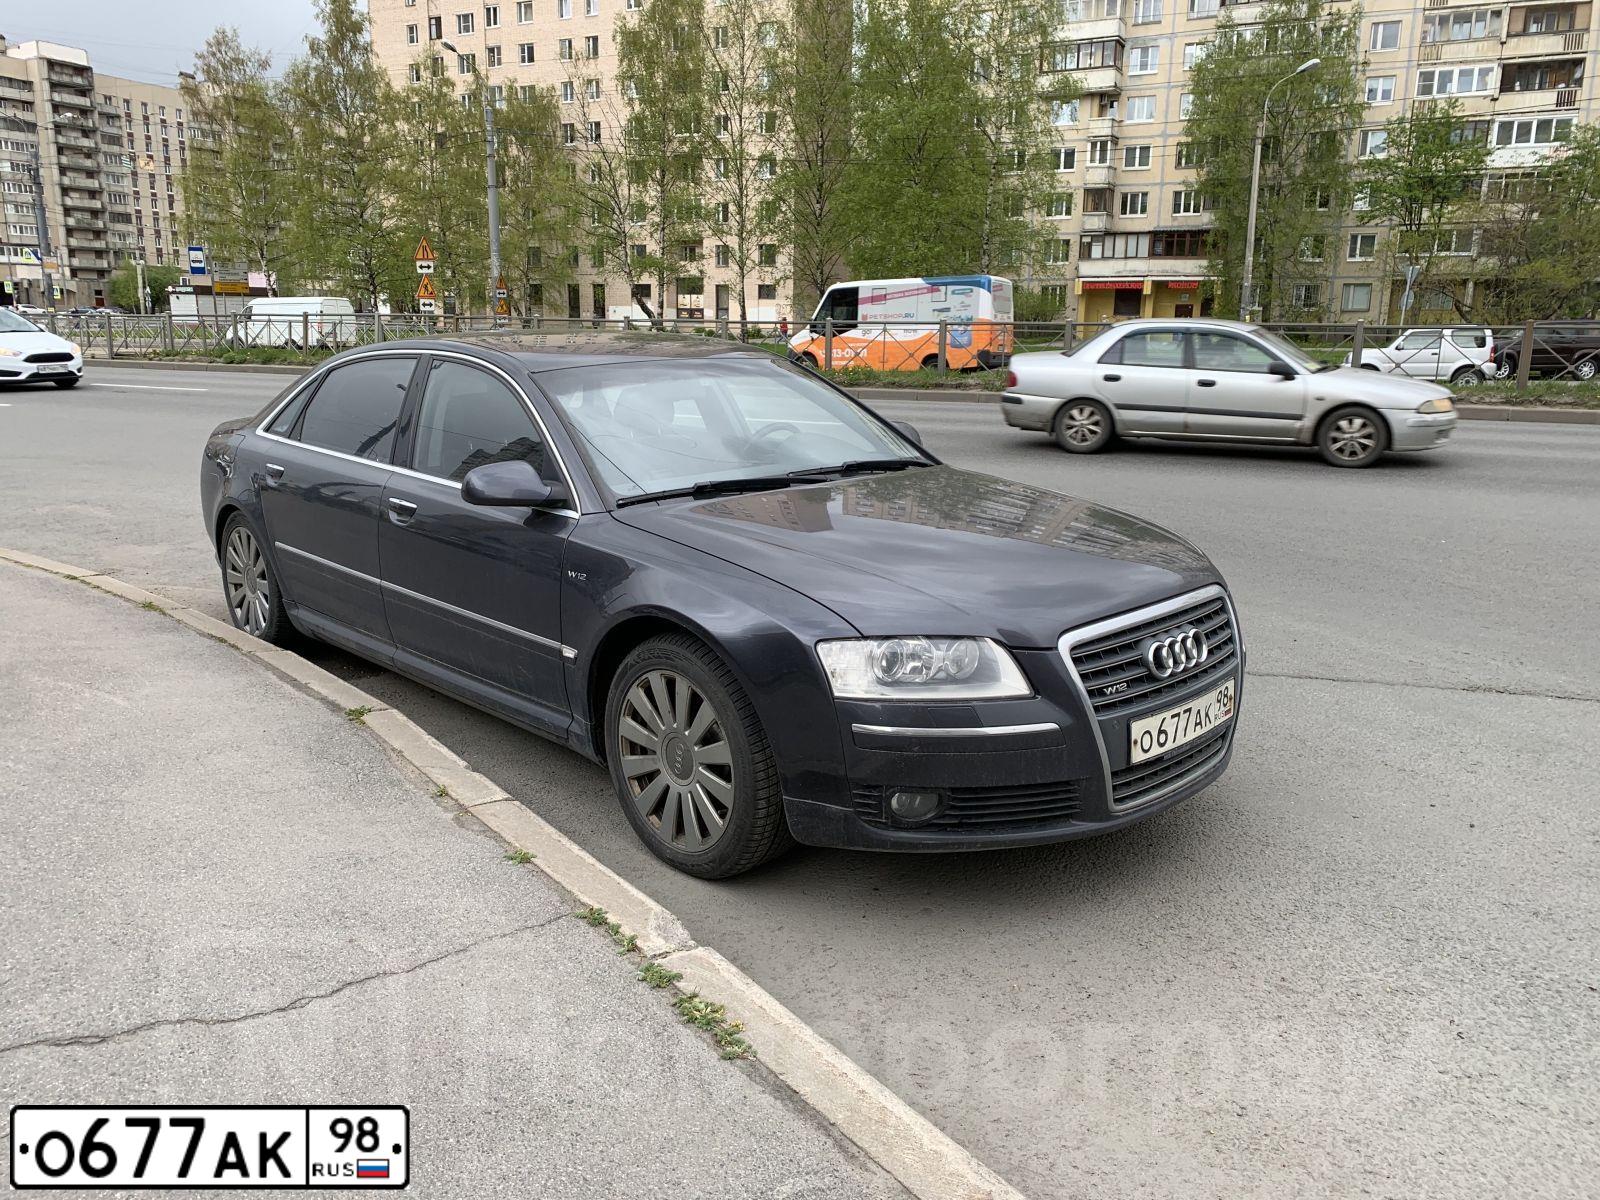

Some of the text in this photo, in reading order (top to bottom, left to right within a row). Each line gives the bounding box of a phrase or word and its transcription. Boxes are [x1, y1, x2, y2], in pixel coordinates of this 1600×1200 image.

[869, 312, 915, 320] PETSHOP.RU
[568, 570, 587, 581] W12
[1103, 682, 1128, 695] W12
[1216, 685, 1229, 712] 98
[1140, 702, 1212, 754] O677AK
